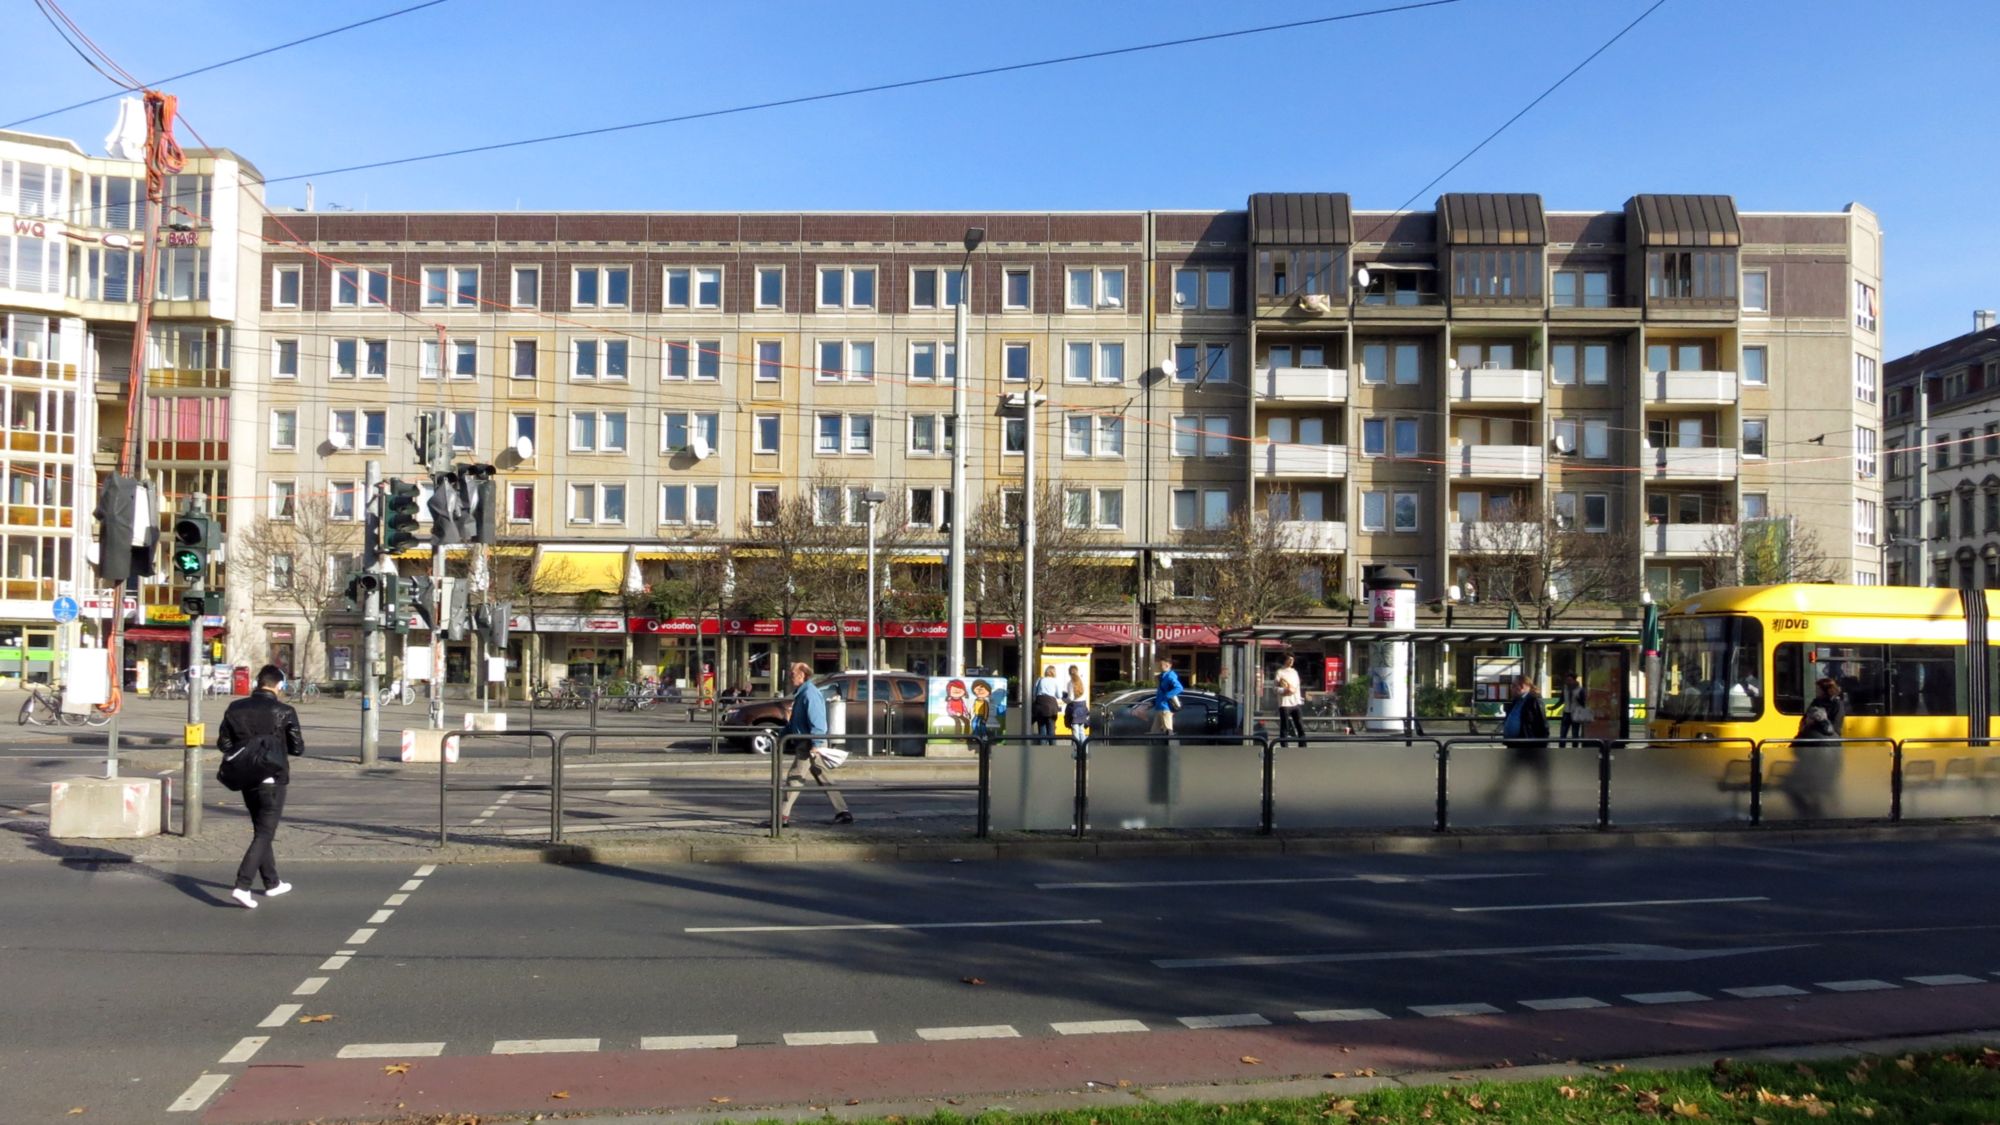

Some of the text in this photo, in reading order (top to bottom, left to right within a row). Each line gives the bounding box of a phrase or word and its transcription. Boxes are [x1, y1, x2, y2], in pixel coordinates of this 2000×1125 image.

[169, 232, 198, 246] BAR
[661, 622, 697, 630] vodafon
[1785, 619, 1809, 629] DVB
